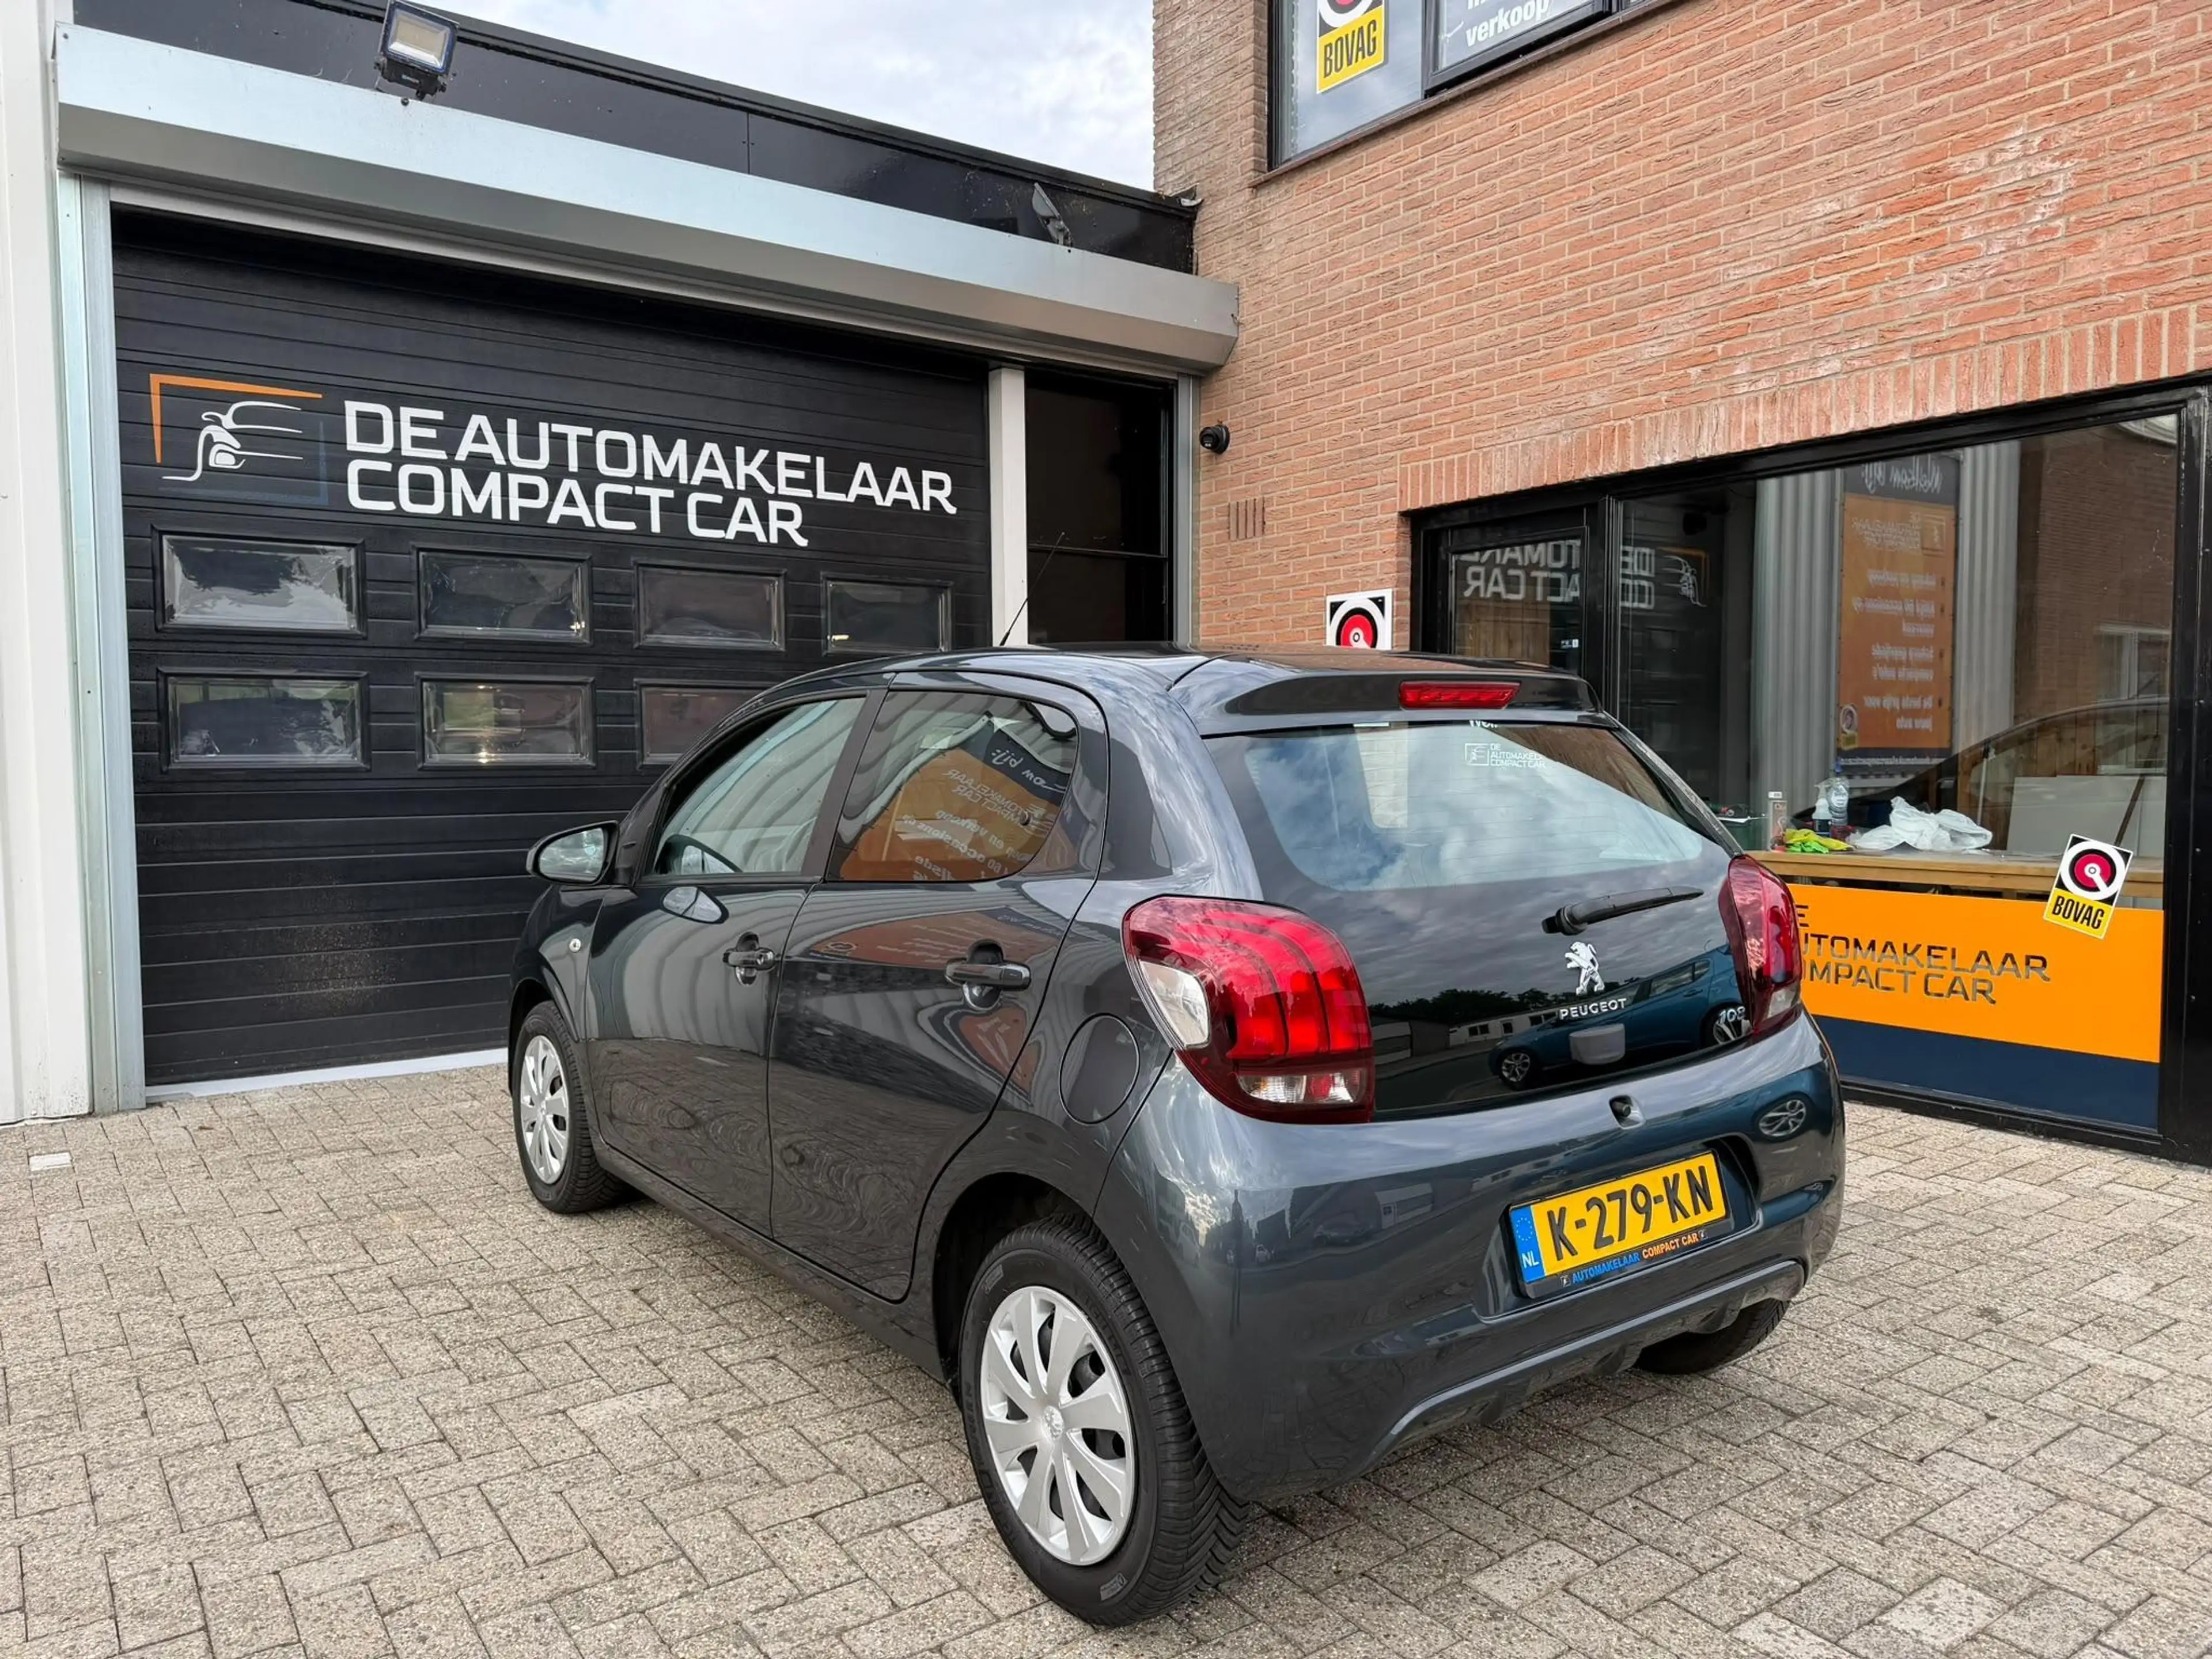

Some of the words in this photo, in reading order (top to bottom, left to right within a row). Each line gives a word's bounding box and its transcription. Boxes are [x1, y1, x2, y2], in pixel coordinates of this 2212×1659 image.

[1465, 0, 1550, 47] verkoop
[1324, 19, 1377, 78] BOVAG
[344, 400, 447, 461] DE
[454, 414, 957, 514] AUTOMAKELAAR
[347, 459, 675, 533] COMPACT
[687, 493, 808, 547] CAR
[1796, 904, 1809, 927] E
[2051, 896, 2105, 929] BOVAG
[1802, 959, 1916, 994] MPACT
[1923, 975, 1997, 1005] CAR
[1559, 998, 1627, 1021] PEUGEOT
[1546, 1165, 1714, 1262] K-279-KN
[1521, 1250, 1540, 1269] NL
[1571, 1253, 1641, 1284] AUTOMAKELAAR
[1642, 1240, 1680, 1260] COMPACT
[1681, 1233, 1699, 1247] CAR
